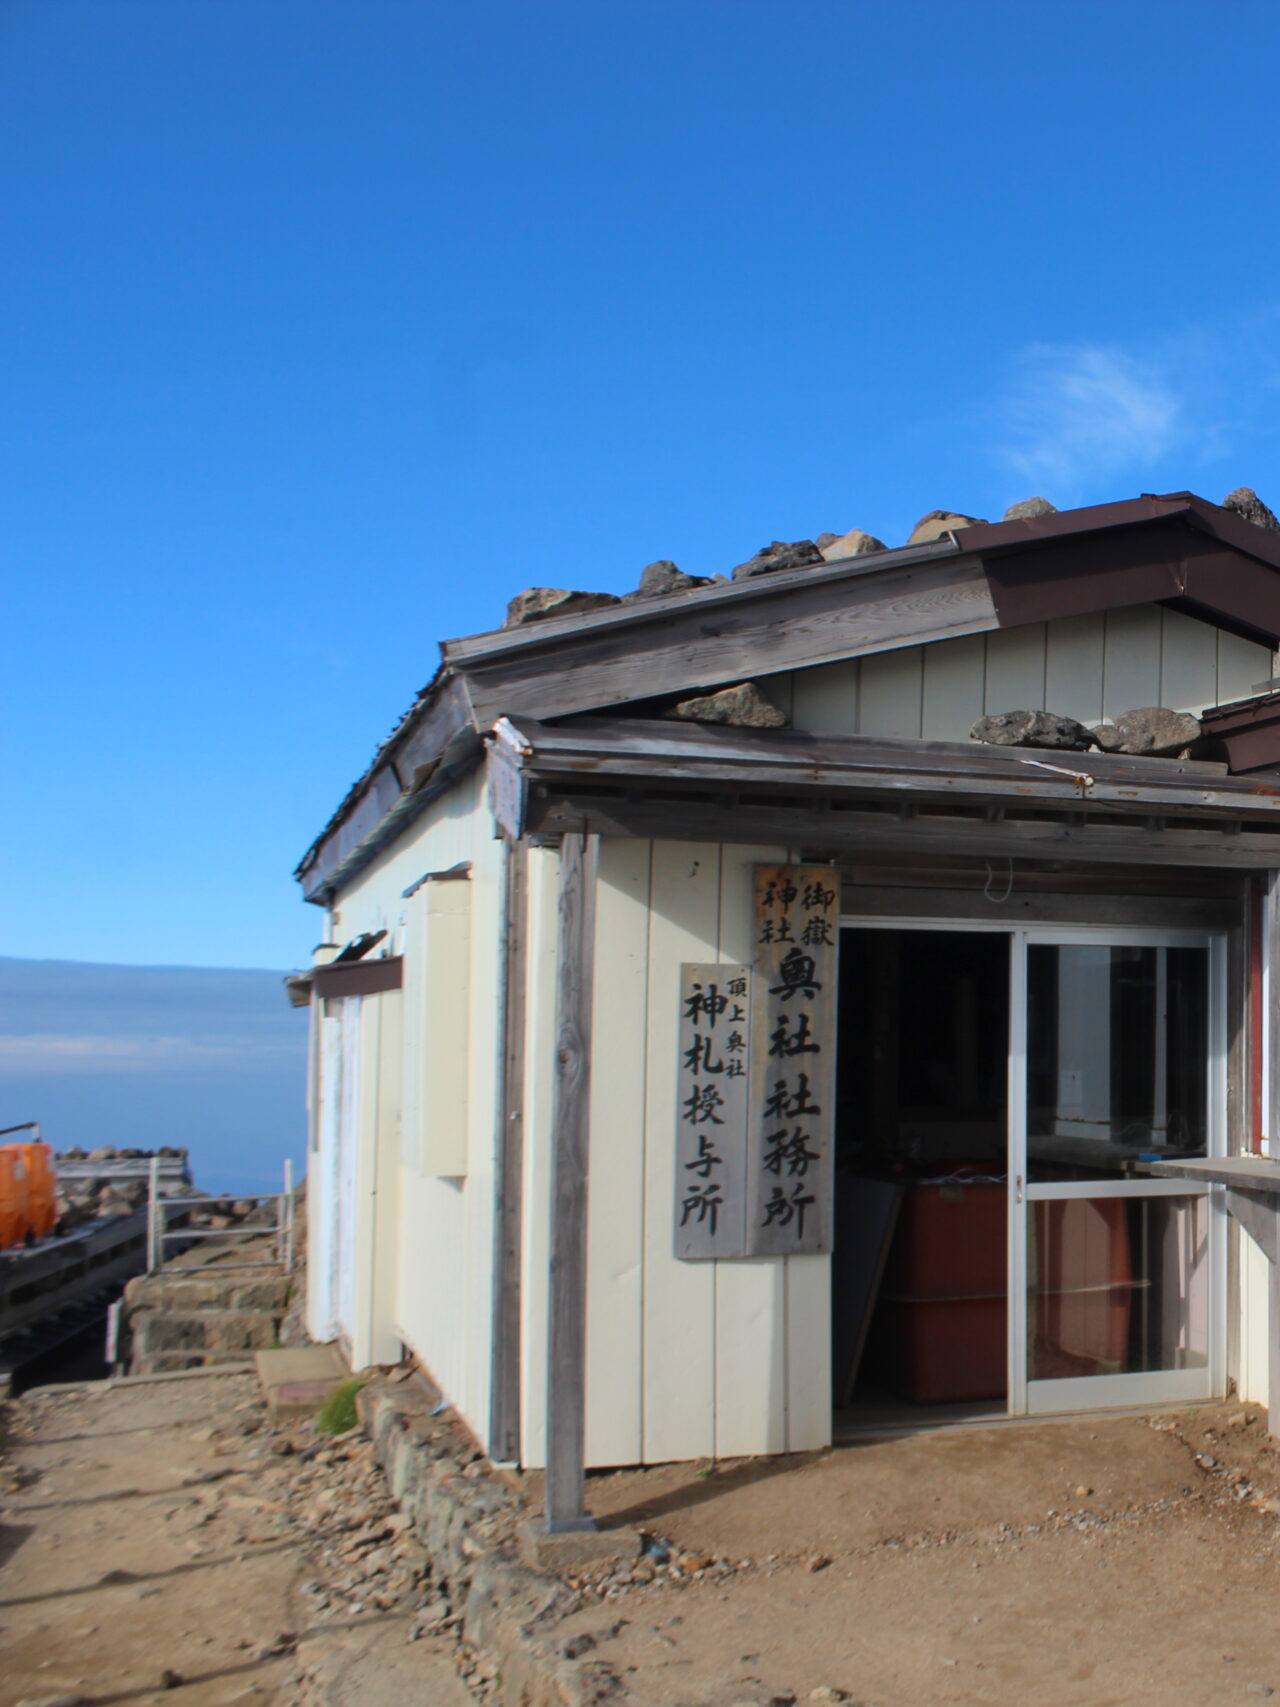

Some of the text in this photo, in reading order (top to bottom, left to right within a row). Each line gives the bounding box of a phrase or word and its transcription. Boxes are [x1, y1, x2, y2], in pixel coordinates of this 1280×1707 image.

[758, 878, 798, 944] 神社
[800, 881, 836, 946] 御嶽
[725, 977, 747, 1079] 頂上奥社
[680, 983, 729, 1236] 神札授与所
